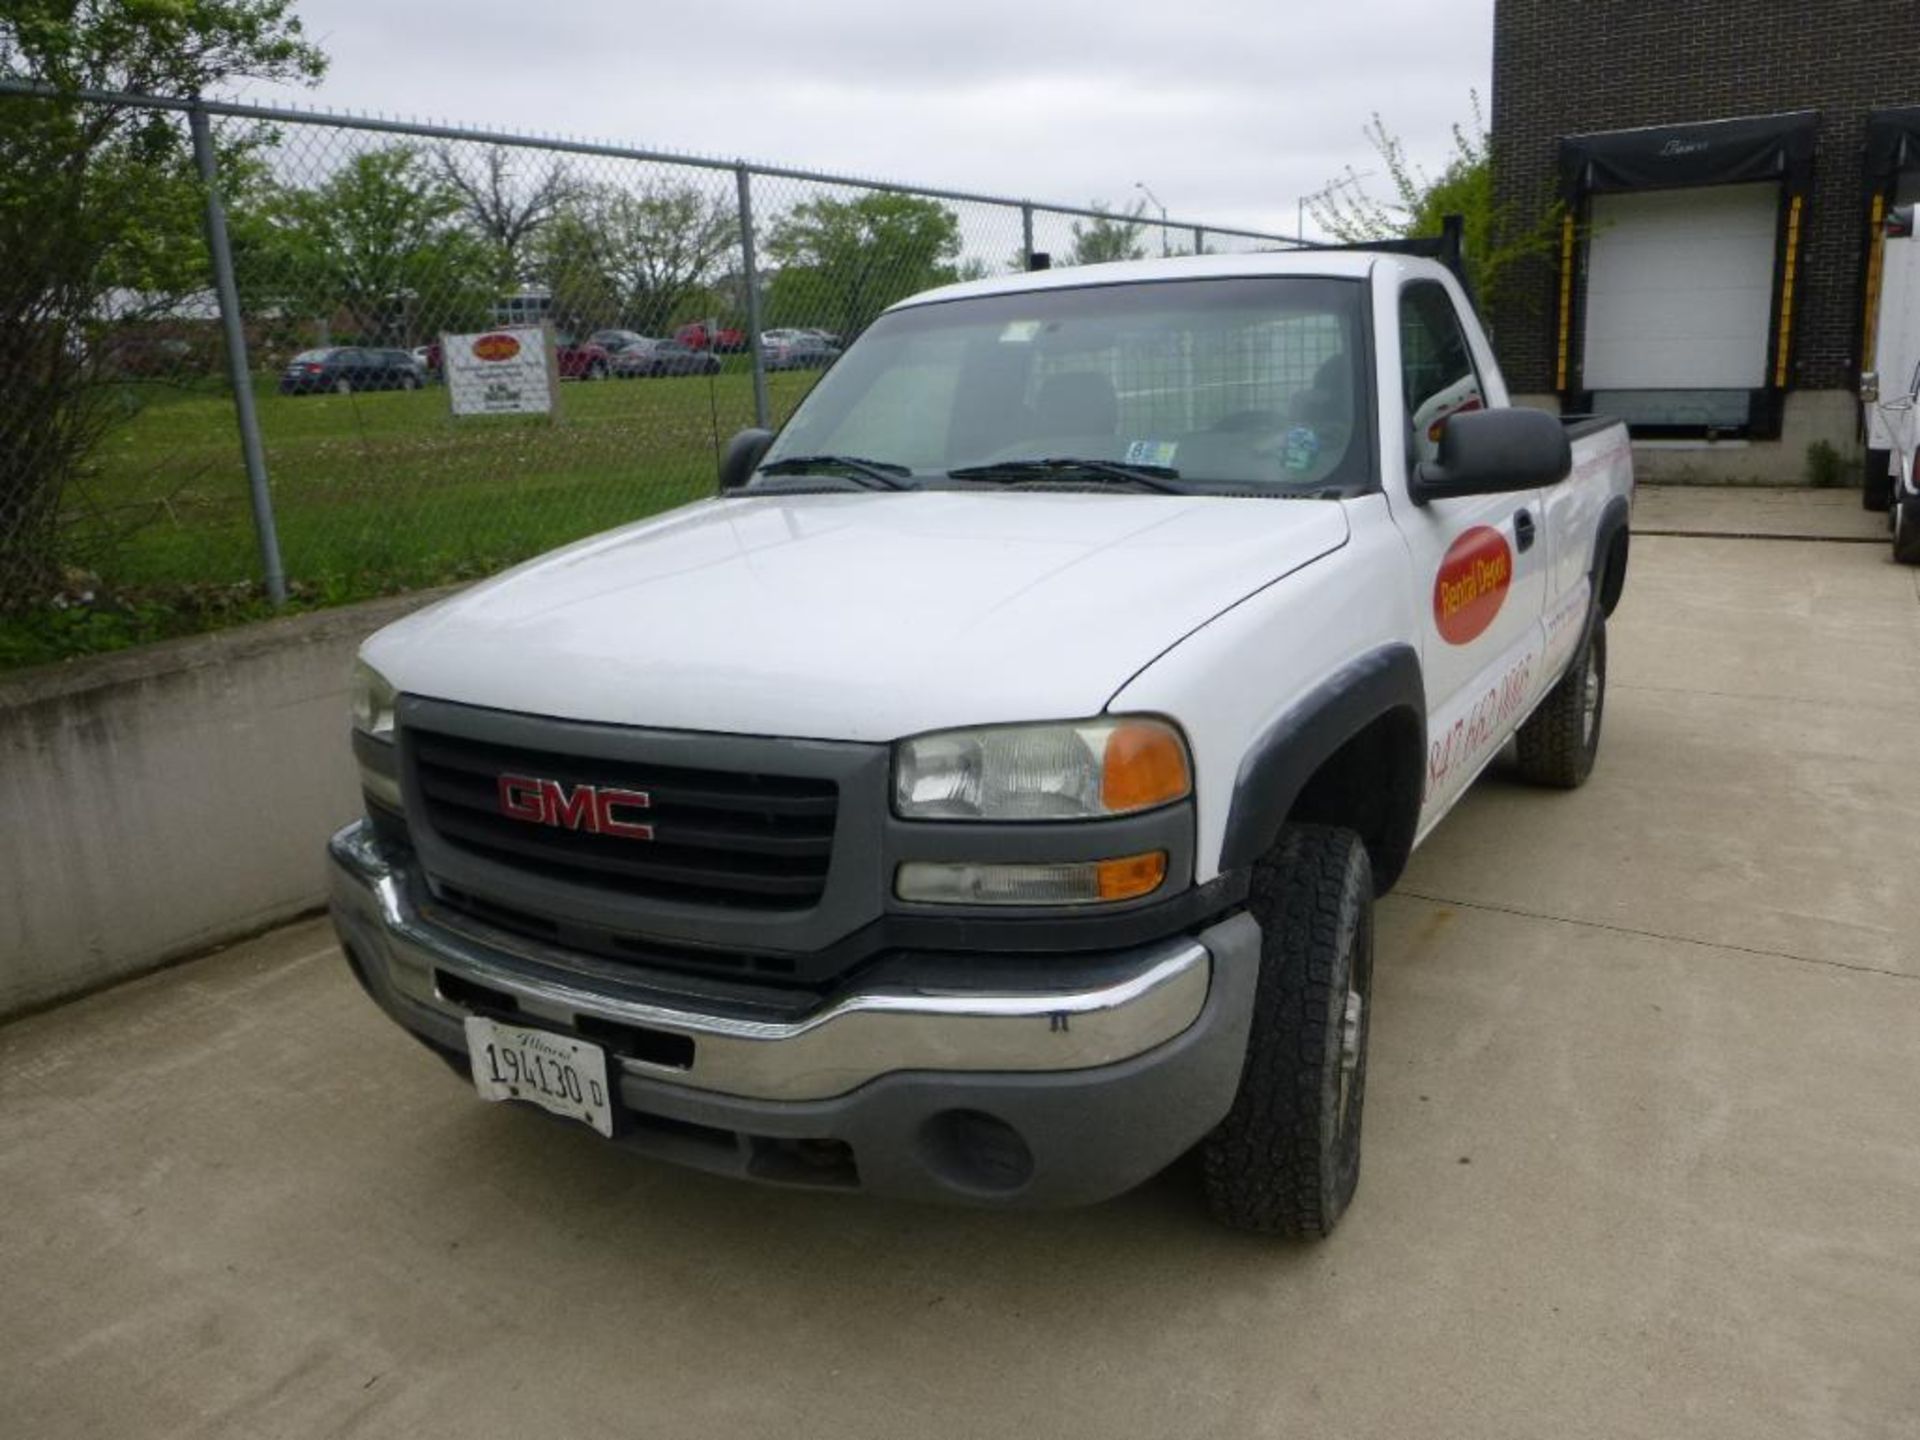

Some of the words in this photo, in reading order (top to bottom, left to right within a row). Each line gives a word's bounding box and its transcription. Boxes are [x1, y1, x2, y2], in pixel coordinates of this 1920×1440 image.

[1441, 560, 1477, 620] Rental
[1478, 546, 1506, 593] Depot
[498, 773, 654, 840] GMC
[486, 1043, 583, 1104] 194130
[589, 1080, 603, 1107] D
[516, 1033, 572, 1061] Illinois
